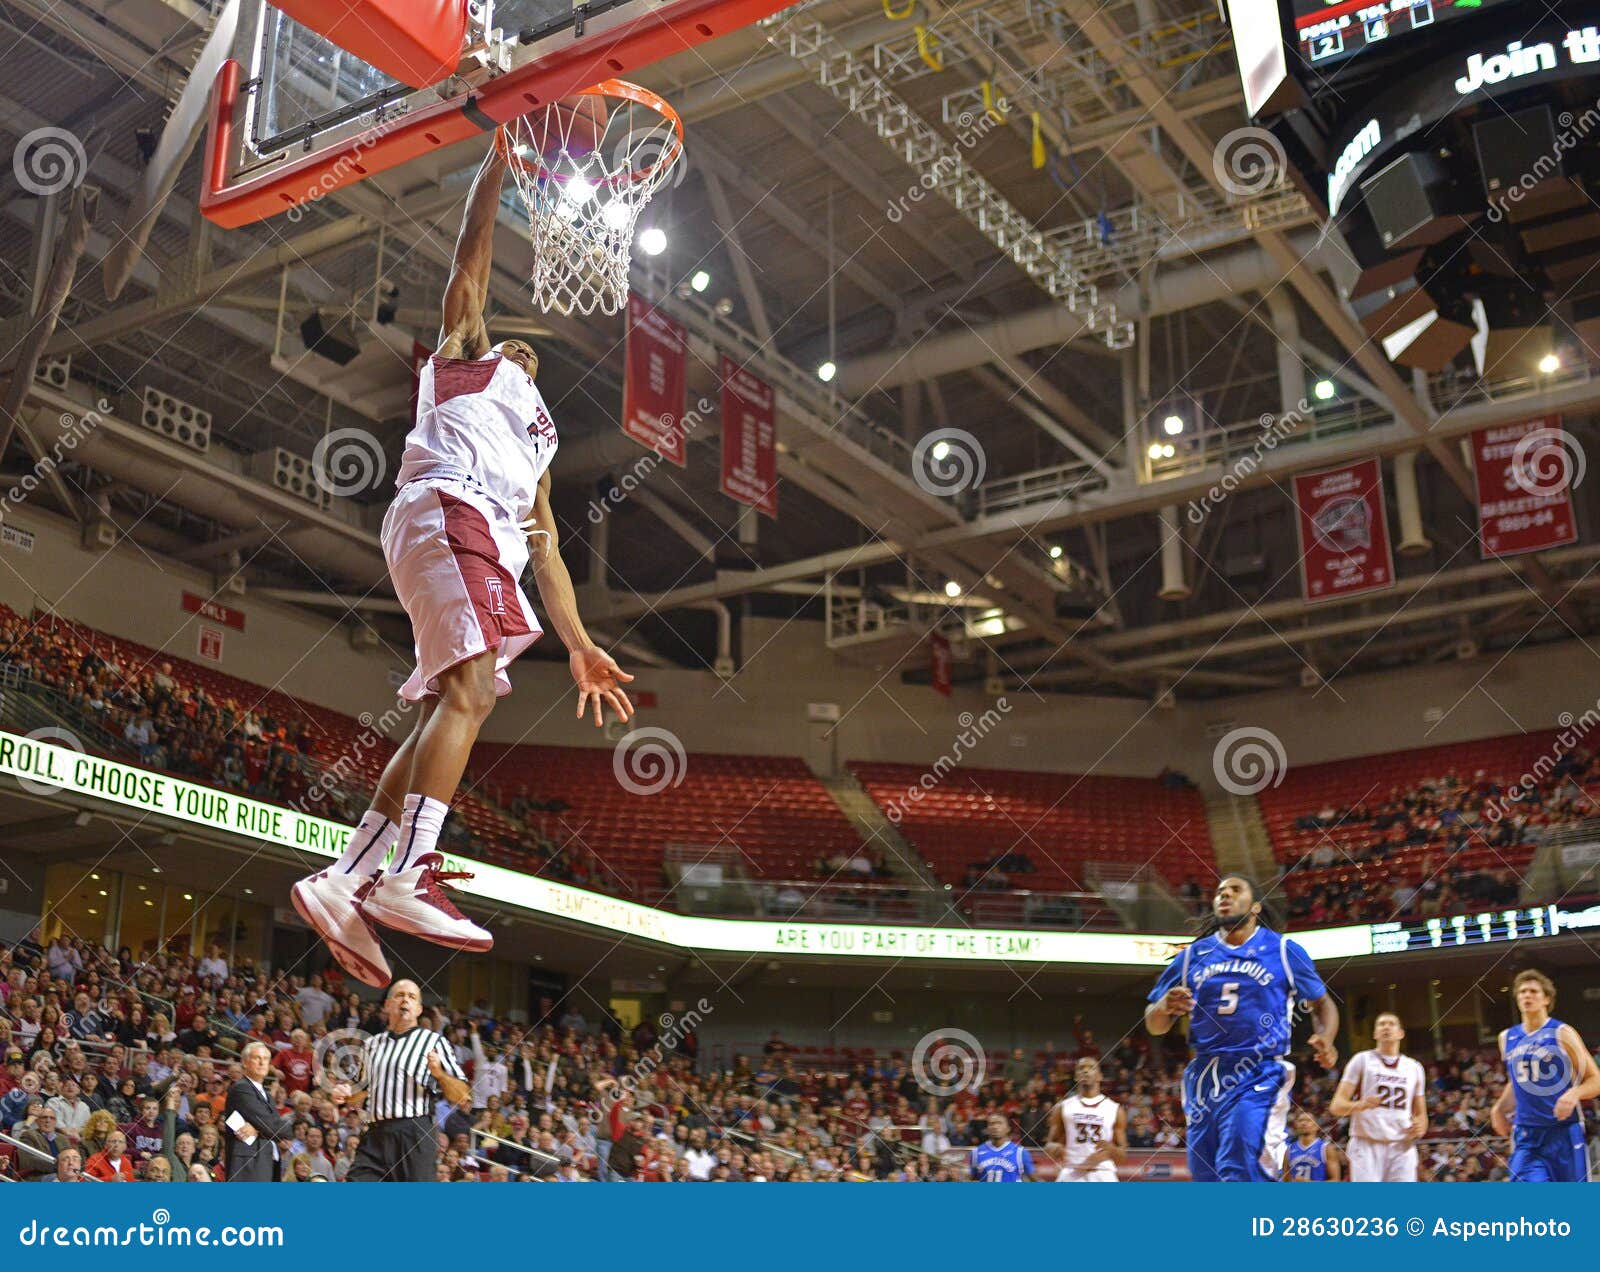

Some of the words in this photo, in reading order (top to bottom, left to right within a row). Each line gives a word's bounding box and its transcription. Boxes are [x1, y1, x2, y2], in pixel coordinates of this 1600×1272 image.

[1318, 37, 1335, 55] 2
[1371, 20, 1388, 38] 4
[1455, 41, 1558, 95] Join
[0, 737, 64, 782] ROLL.
[74, 758, 165, 808] CHOOSE
[174, 784, 228, 825] YOUR
[236, 801, 287, 840] RIDE.
[776, 928, 809, 949] ARE
[818, 930, 855, 950] YOU
[863, 931, 908, 952] PART
[916, 933, 936, 952] OF
[945, 934, 977, 954] THE
[1232, 957, 1276, 987] LOUIS
[1216, 982, 1241, 1015] 5
[1516, 1059, 1540, 1083] 51
[1377, 1084, 1407, 1110] 22
[1075, 1122, 1103, 1144] 33
